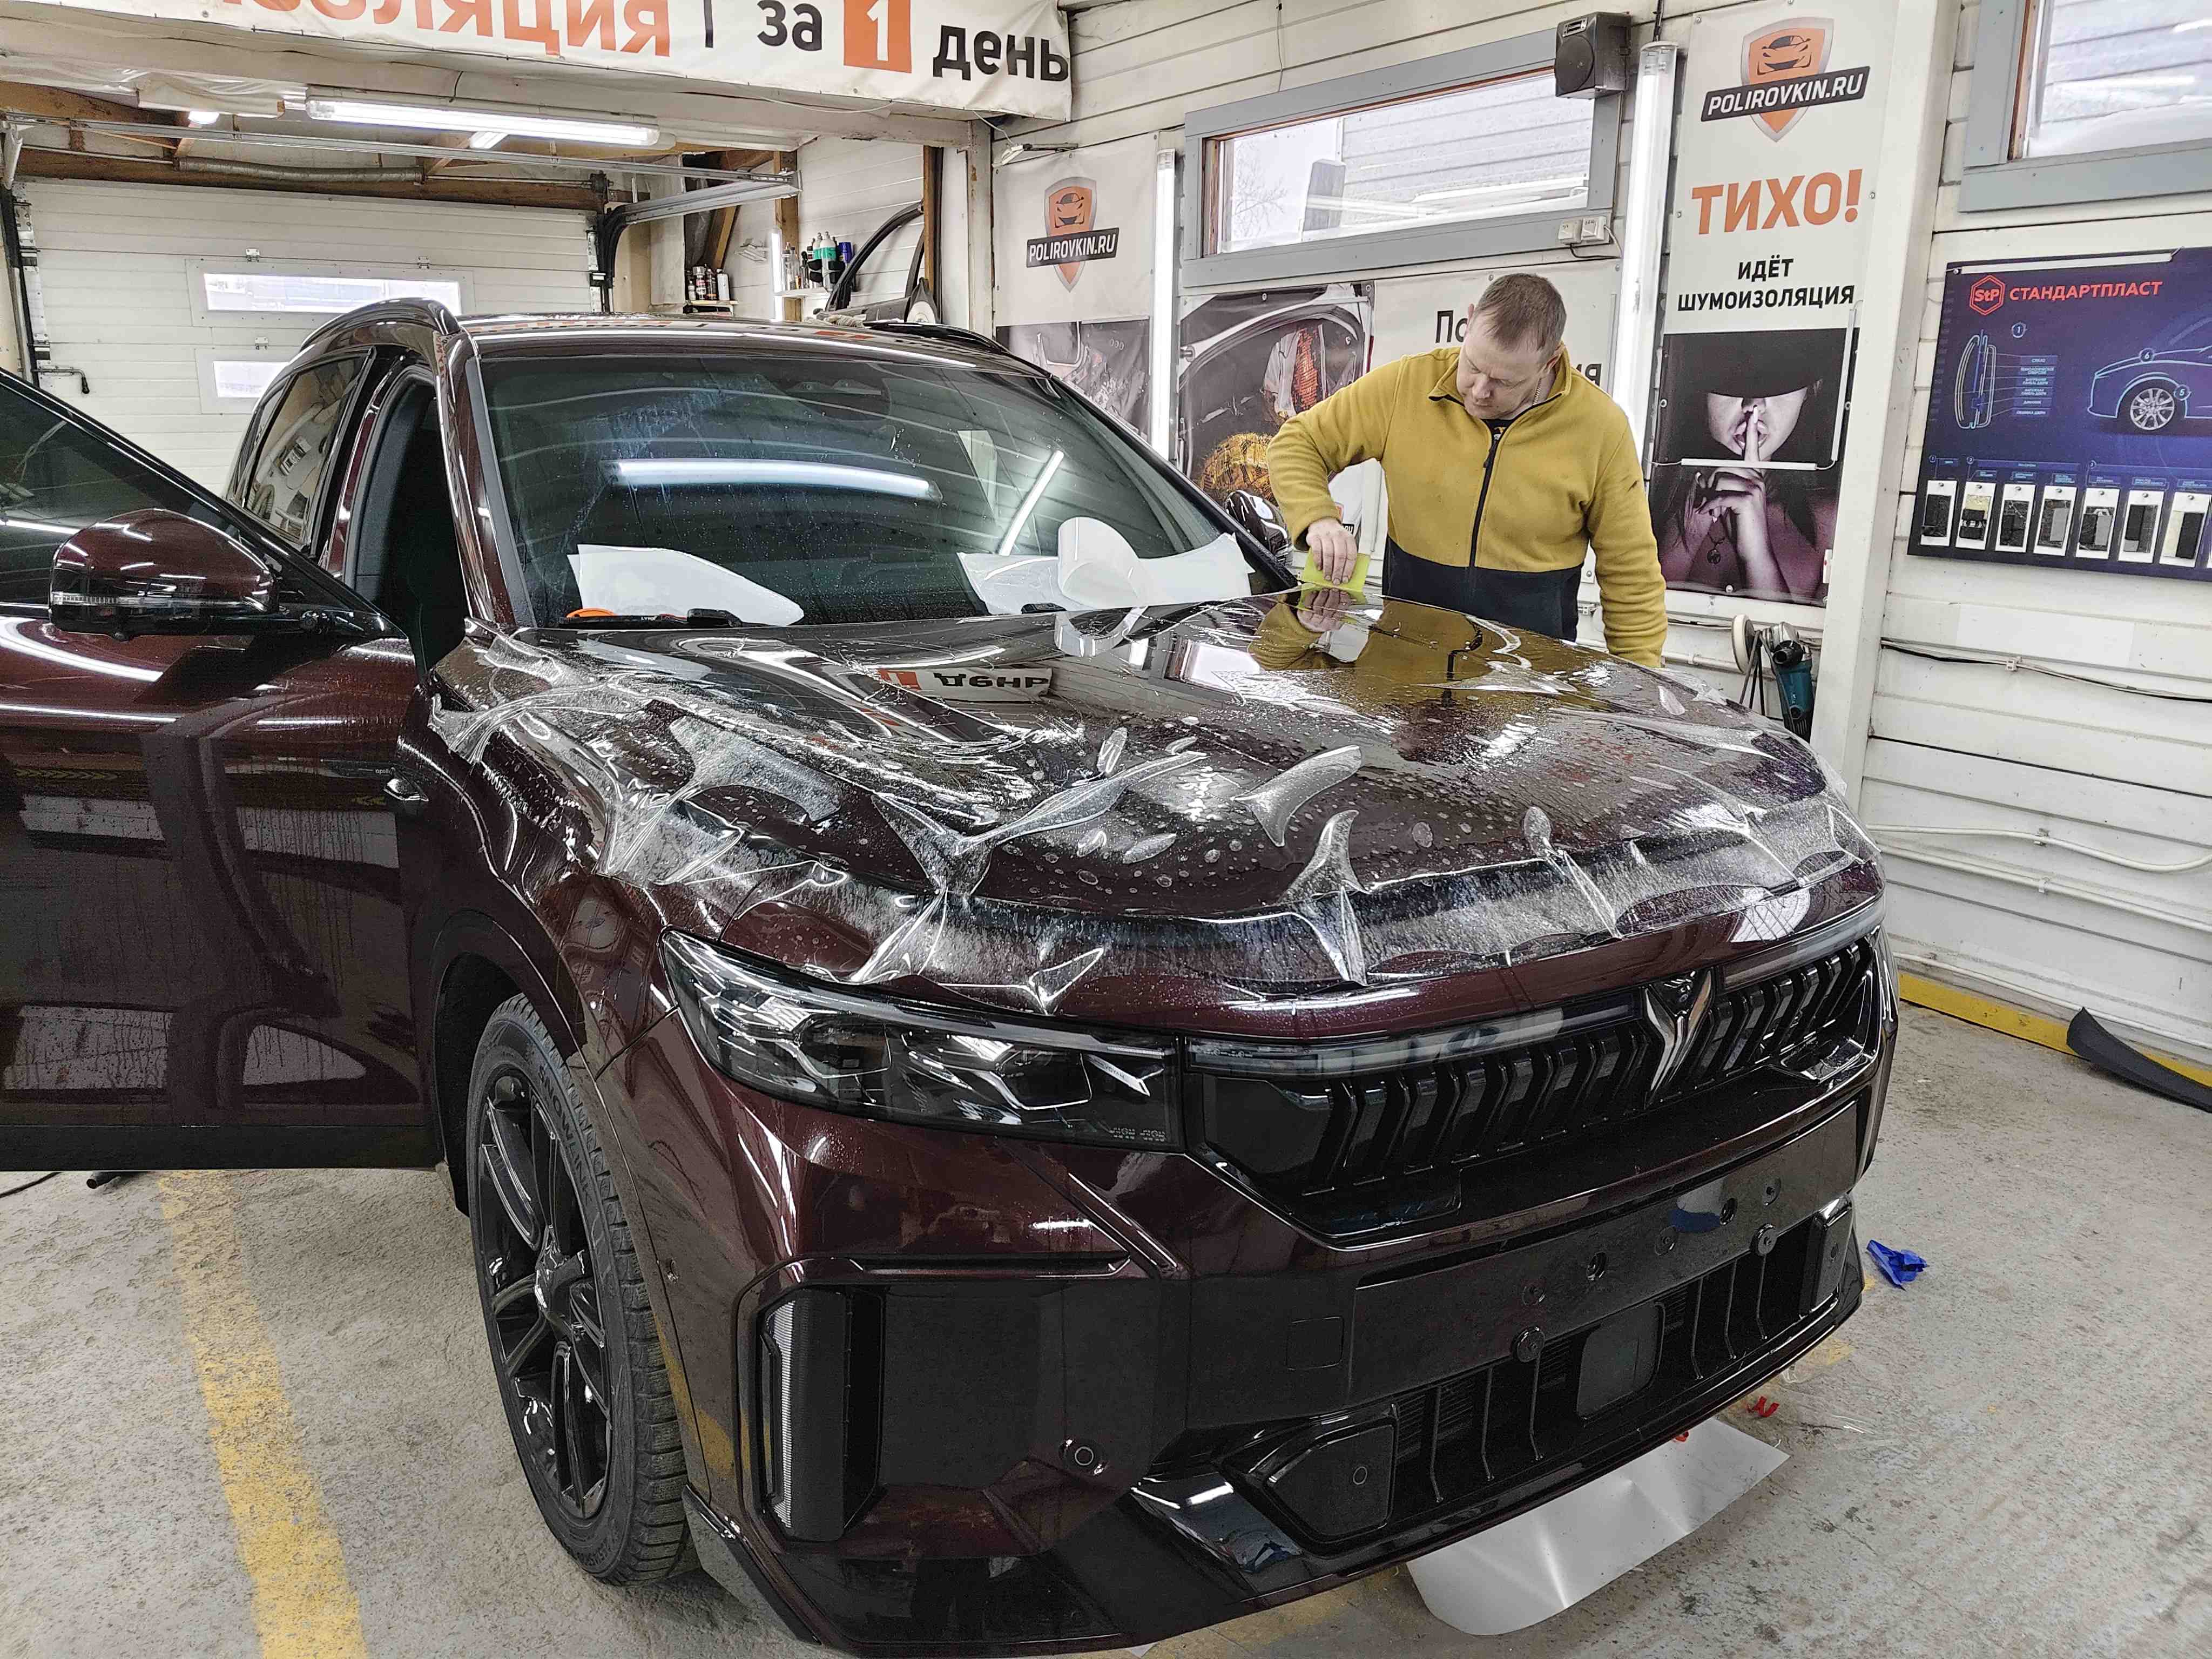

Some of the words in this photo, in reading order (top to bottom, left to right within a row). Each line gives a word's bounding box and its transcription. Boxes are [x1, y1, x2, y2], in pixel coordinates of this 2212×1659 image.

[223, 0, 671, 57] ЯЦИЯ
[757, 0, 822, 51] за
[866, 0, 889, 62] 1
[933, 24, 1069, 82] день
[1708, 73, 1864, 116] POLIROVKIN.RU
[1691, 168, 1863, 234] ТИХО!
[1029, 234, 1116, 262] POLIROVKIN.RU
[1737, 254, 1794, 282] ИДЁТ
[1677, 285, 1855, 312] ШУМОИЗОЛЯЦИЯ
[2009, 281, 2163, 301] СТАНДАРТПЛАСТ
